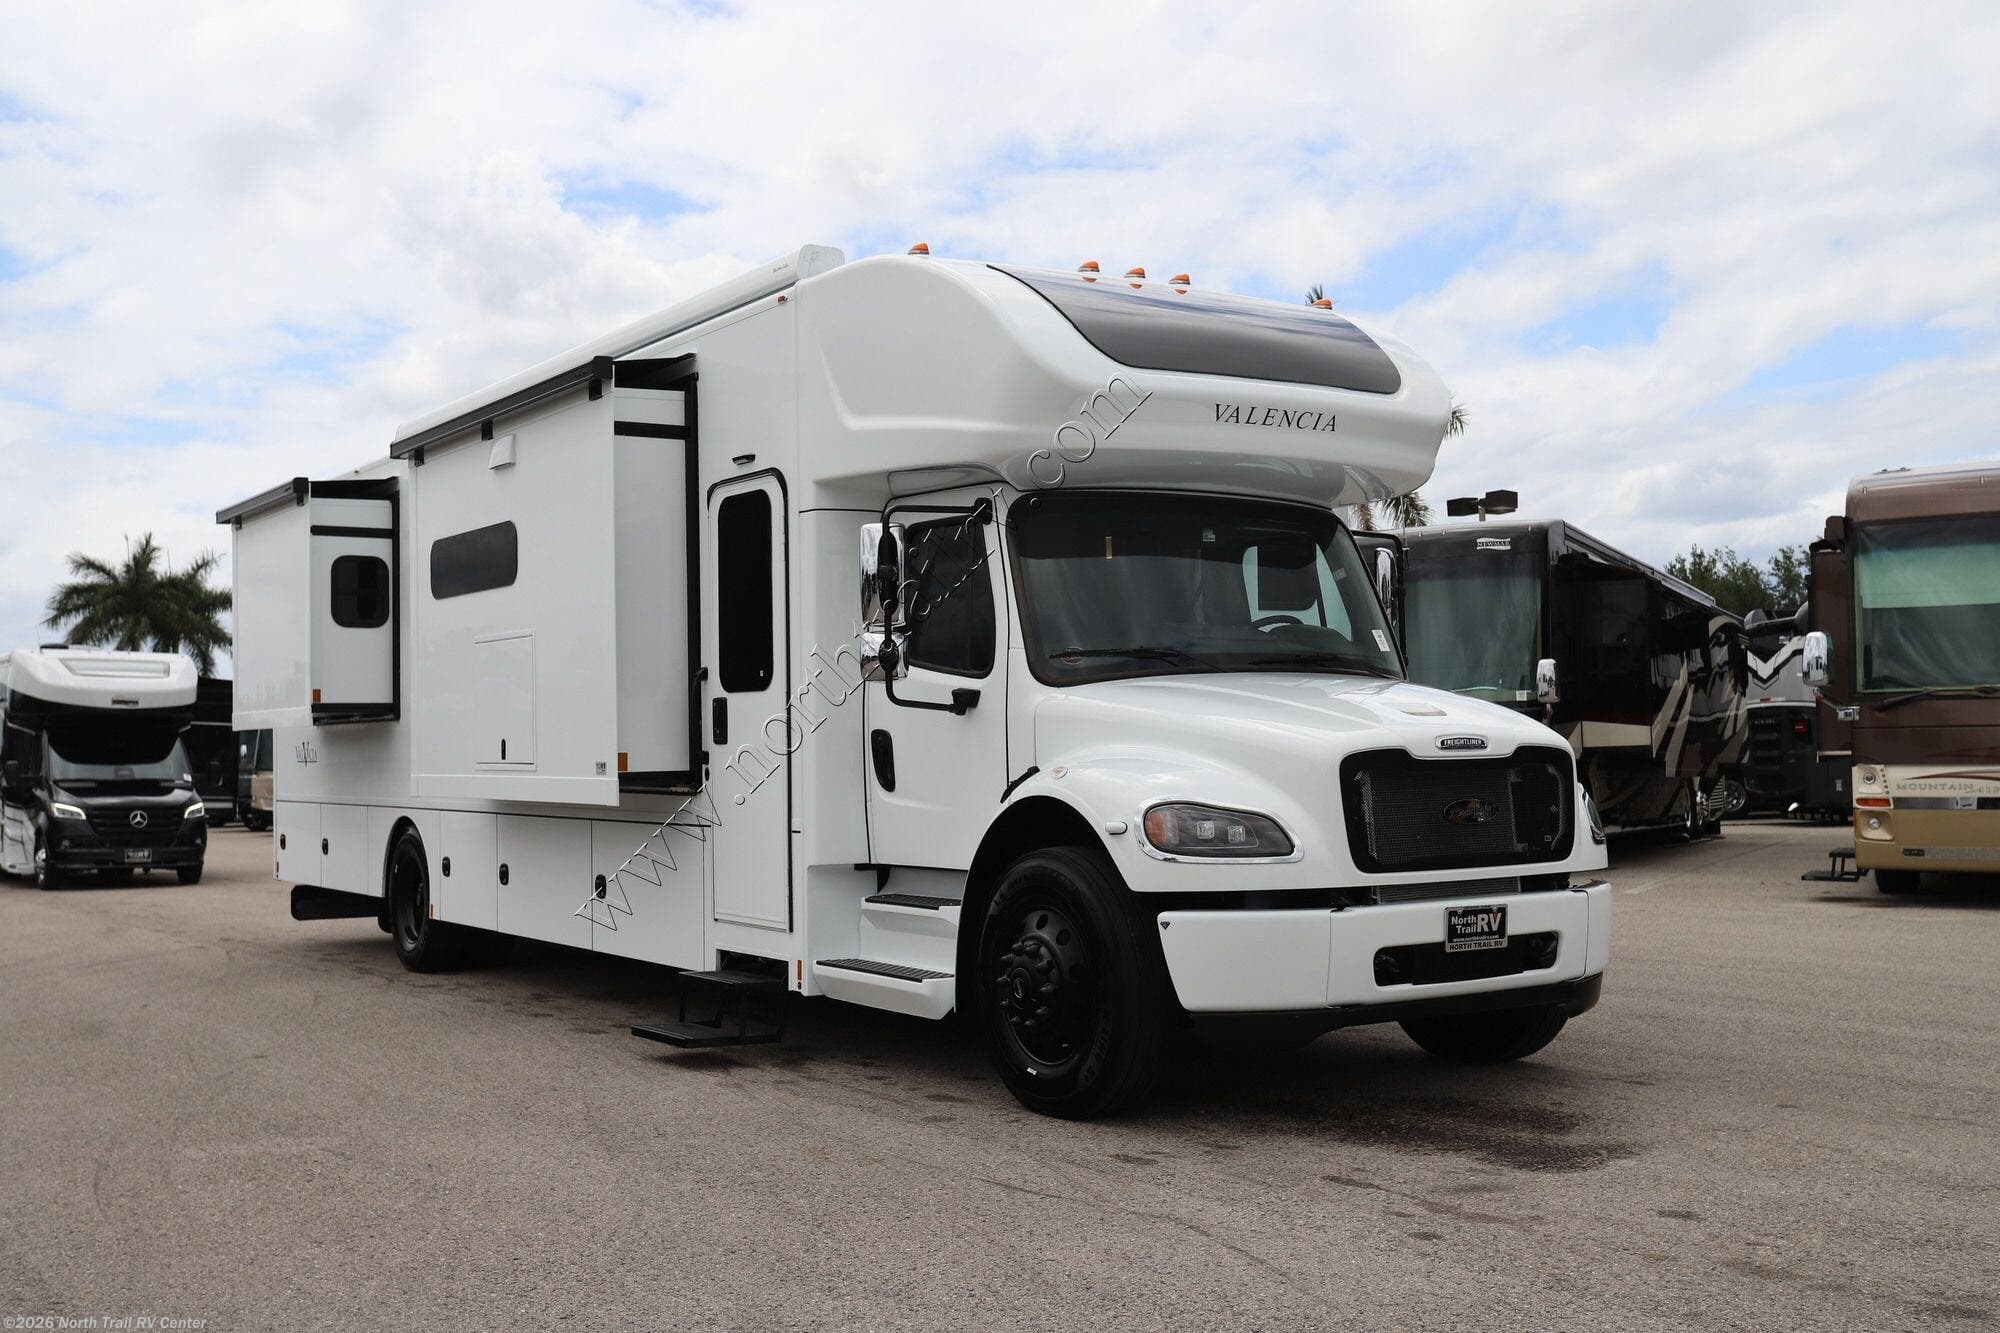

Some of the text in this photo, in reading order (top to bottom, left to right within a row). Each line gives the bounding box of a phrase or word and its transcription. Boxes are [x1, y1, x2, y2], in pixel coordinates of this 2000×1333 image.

[1215, 403, 1336, 432] VALENCIA
[1896, 783, 1974, 791] MOUNTAIN
[1451, 912, 1502, 933] North RV
[1456, 924, 1477, 934] Trail
[1449, 942, 1472, 951] NORTH
[1473, 941, 1493, 949] TRAIL
